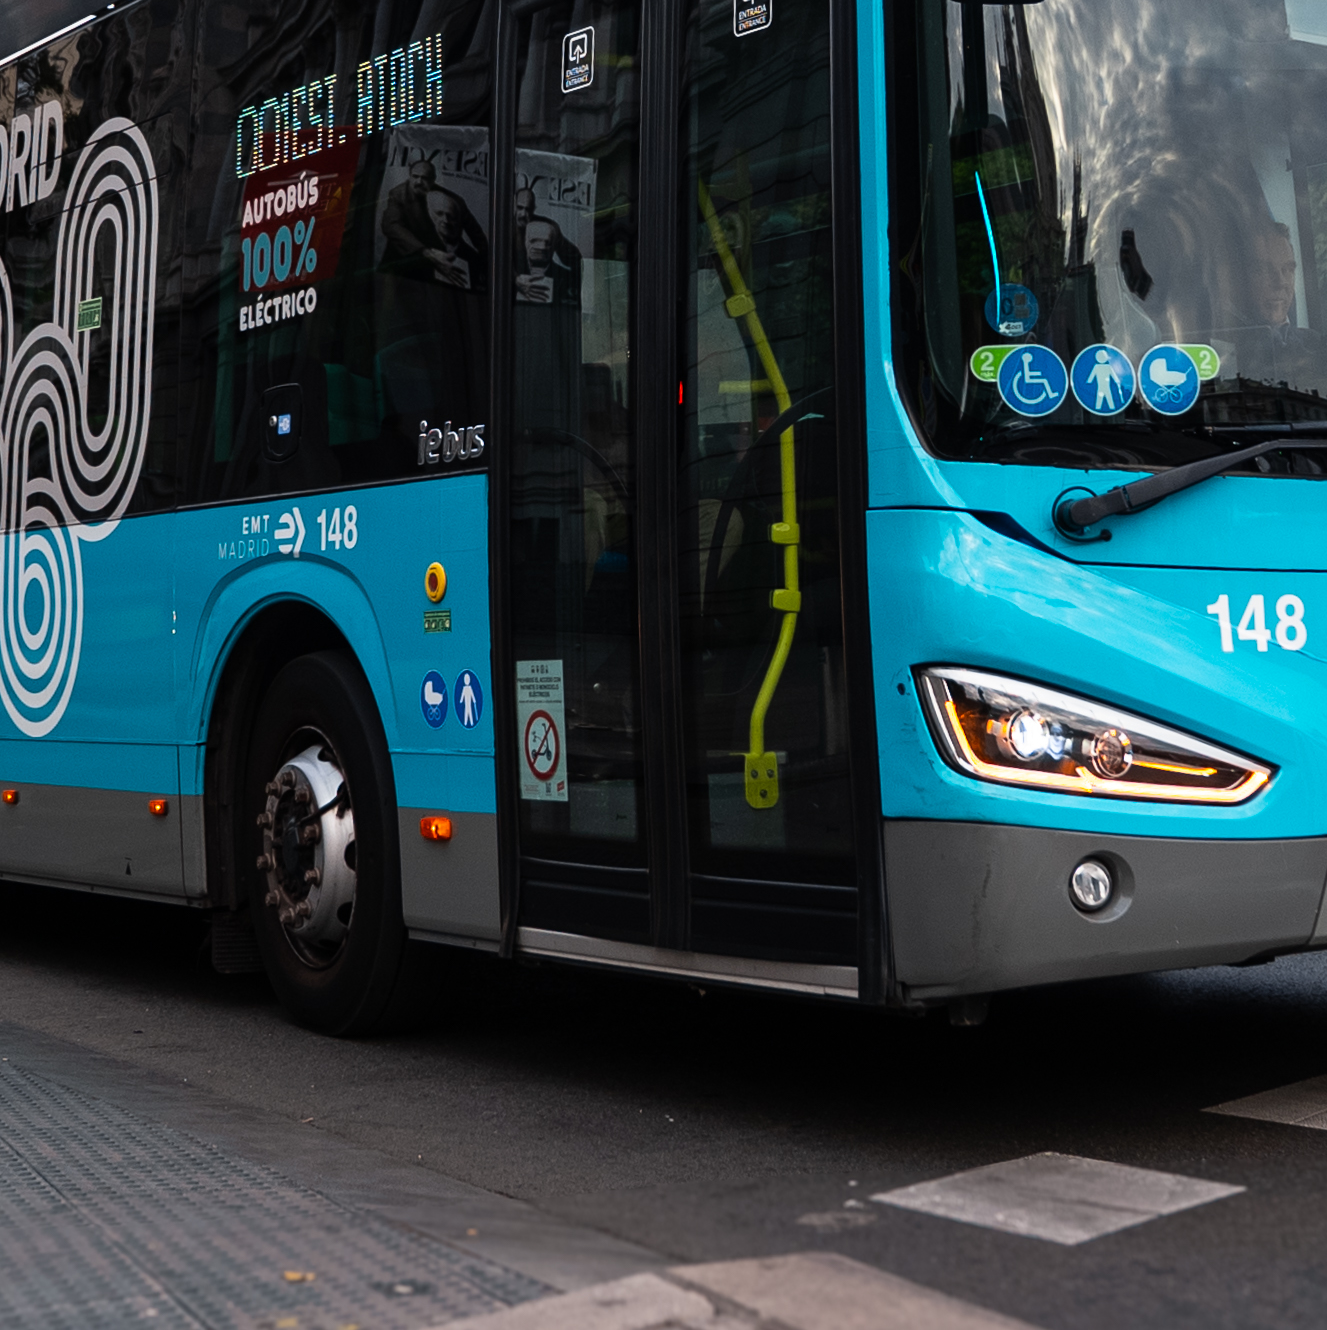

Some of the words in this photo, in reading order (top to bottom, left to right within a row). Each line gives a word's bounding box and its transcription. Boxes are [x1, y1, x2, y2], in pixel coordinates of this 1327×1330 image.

[357, 33, 443, 138] ATOCH
[242, 171, 319, 228] AUTOBÚS
[242, 216, 318, 291] 100%
[239, 287, 318, 332] ELÉCTRICO
[980, 351, 994, 371] 2
[1199, 350, 1212, 369] 2
[218, 538, 270, 561] MADRID
[242, 515, 270, 535] EMT
[317, 505, 358, 551] 148
[1206, 594, 1307, 652] 148
